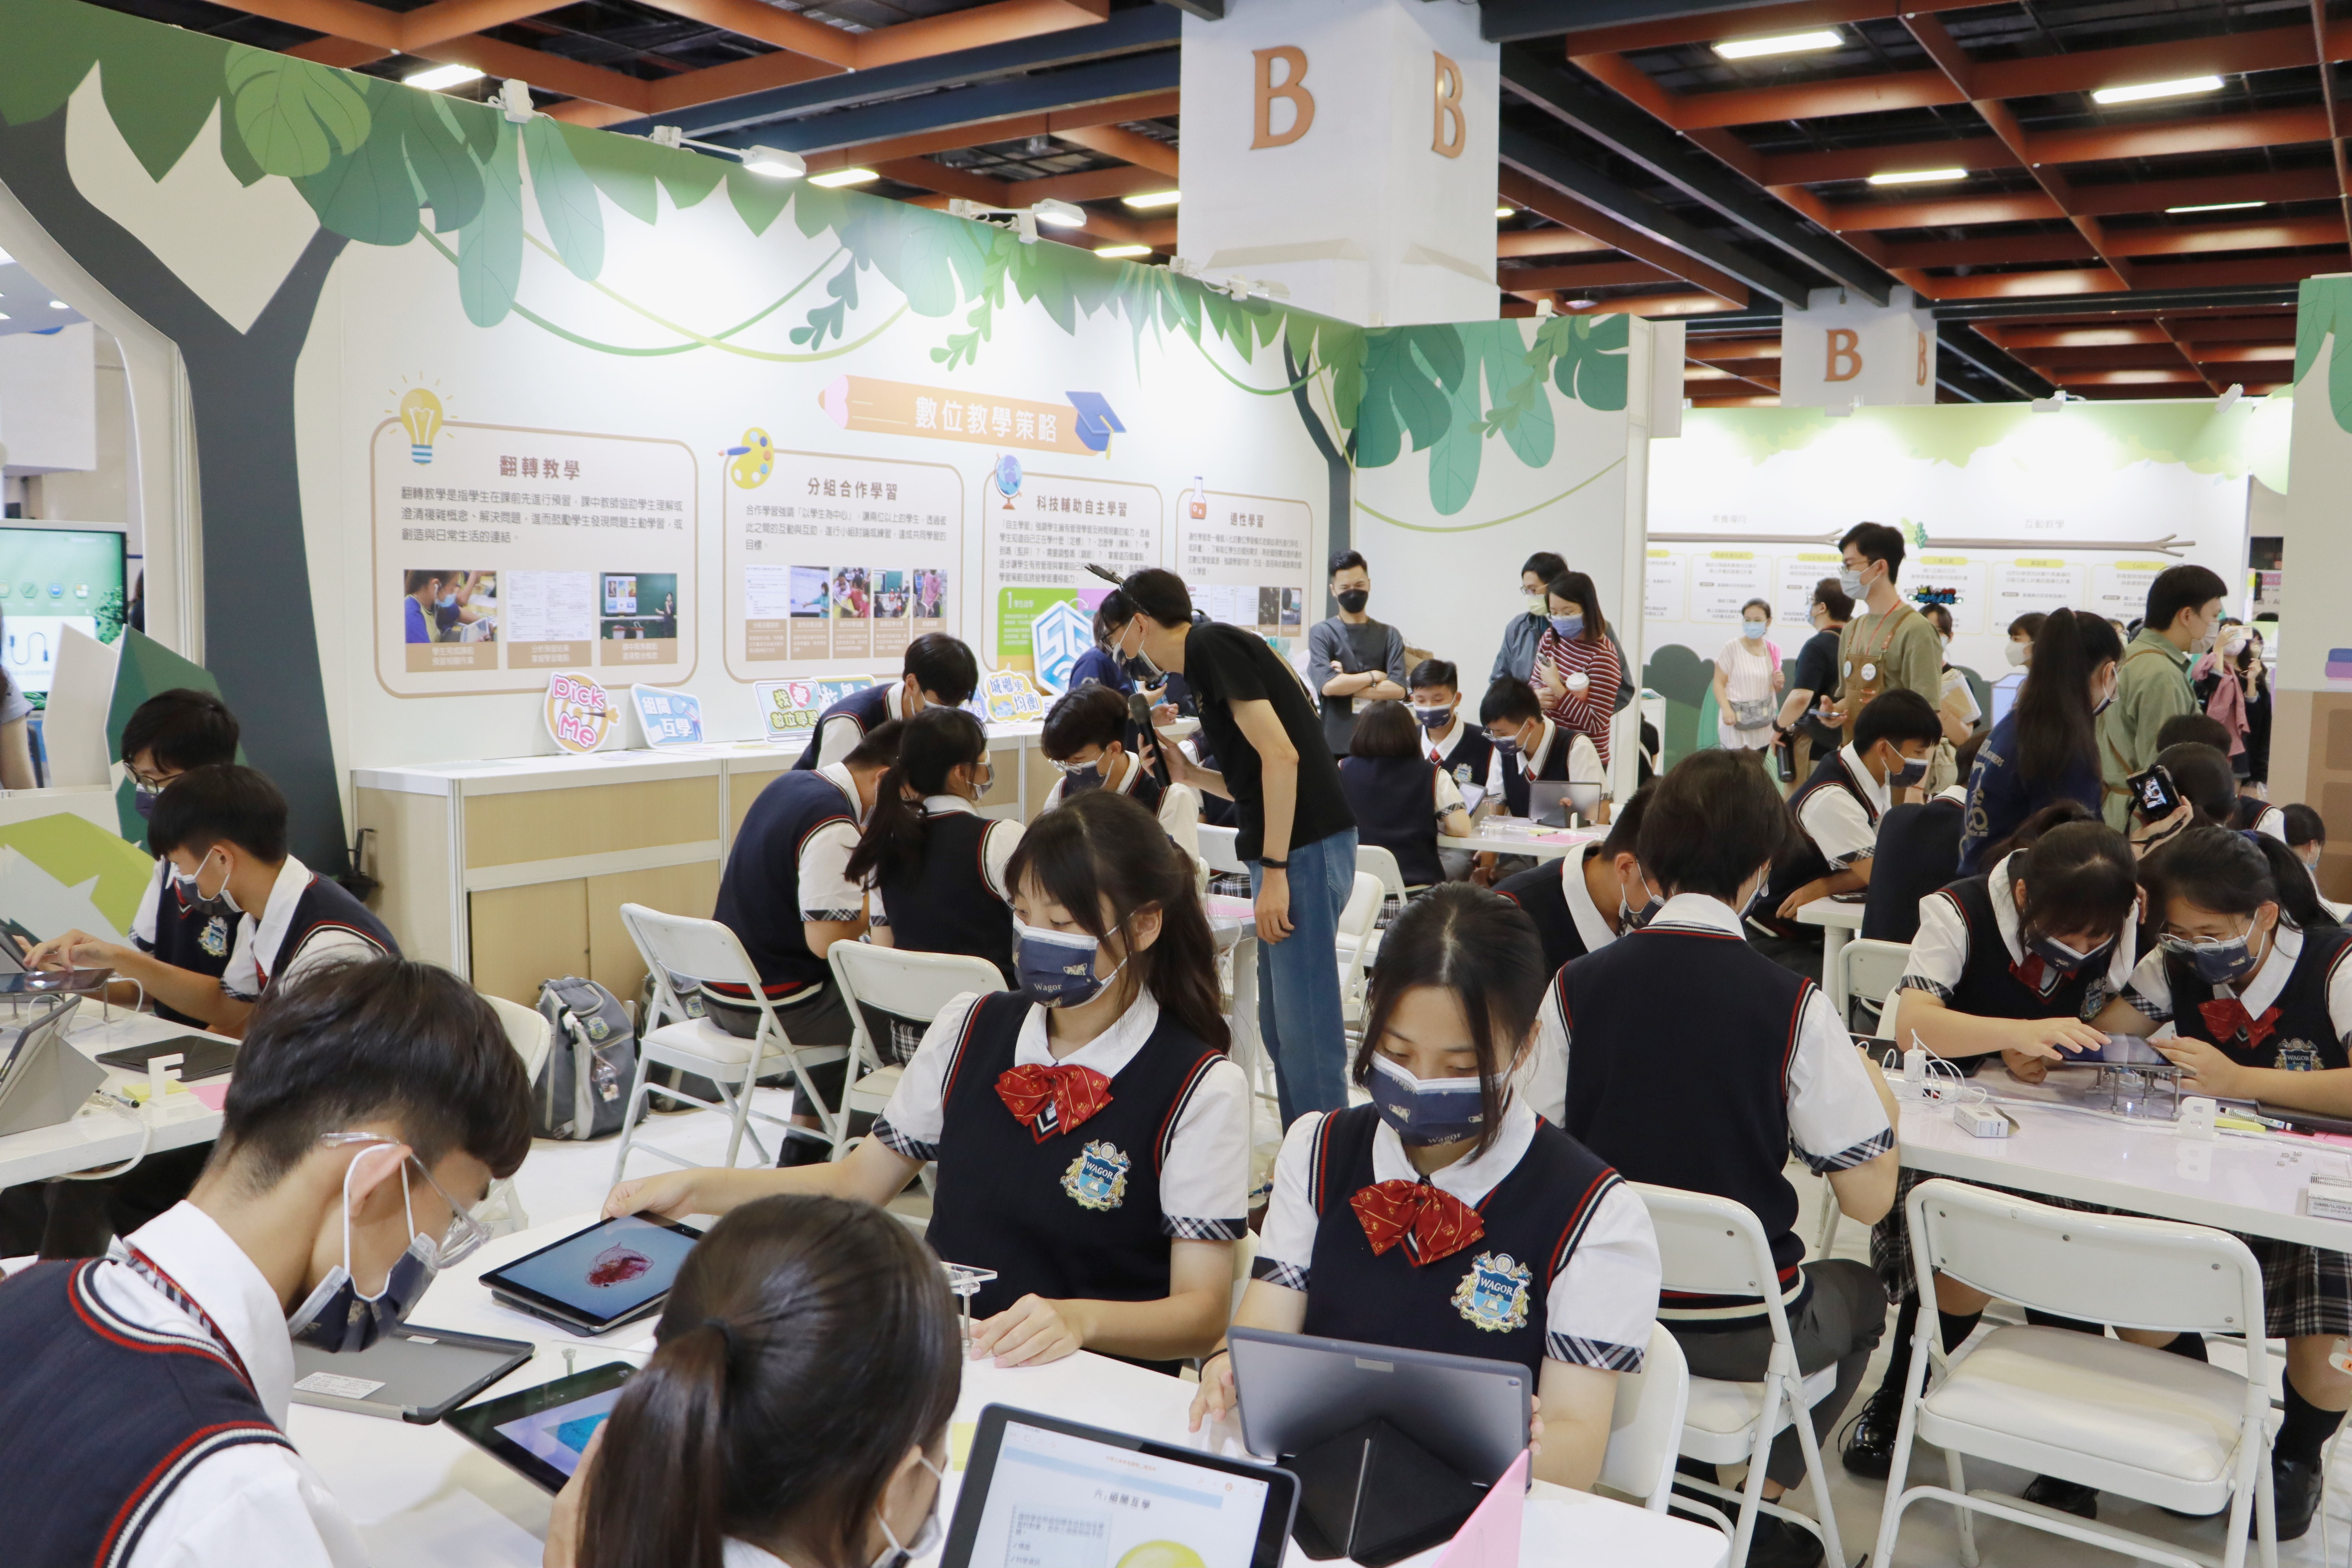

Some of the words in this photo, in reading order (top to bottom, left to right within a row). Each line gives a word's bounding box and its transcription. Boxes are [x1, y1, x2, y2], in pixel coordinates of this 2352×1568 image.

[1249, 45, 1315, 150] B
[1431, 51, 1466, 159] B
[1824, 328, 1862, 382] B
[1916, 331, 1927, 387] B
[915, 396, 1057, 443] 數位教學策略
[499, 455, 580, 480] 翻轉教學
[808, 477, 897, 501] 分組合作學習
[1037, 495, 1127, 517] 科技輔助自主學習
[1230, 512, 1264, 528] 適性學習
[2024, 519, 2065, 529] 互動教學
[1007, 591, 1013, 609] 1
[642, 697, 672, 715] 組間
[772, 685, 808, 710] 我愛
[558, 711, 597, 748] Me
[1034, 982, 1062, 993] Wagor
[1086, 1161, 1114, 1180] WAGOR
[1481, 1276, 1514, 1297] WAGOR
